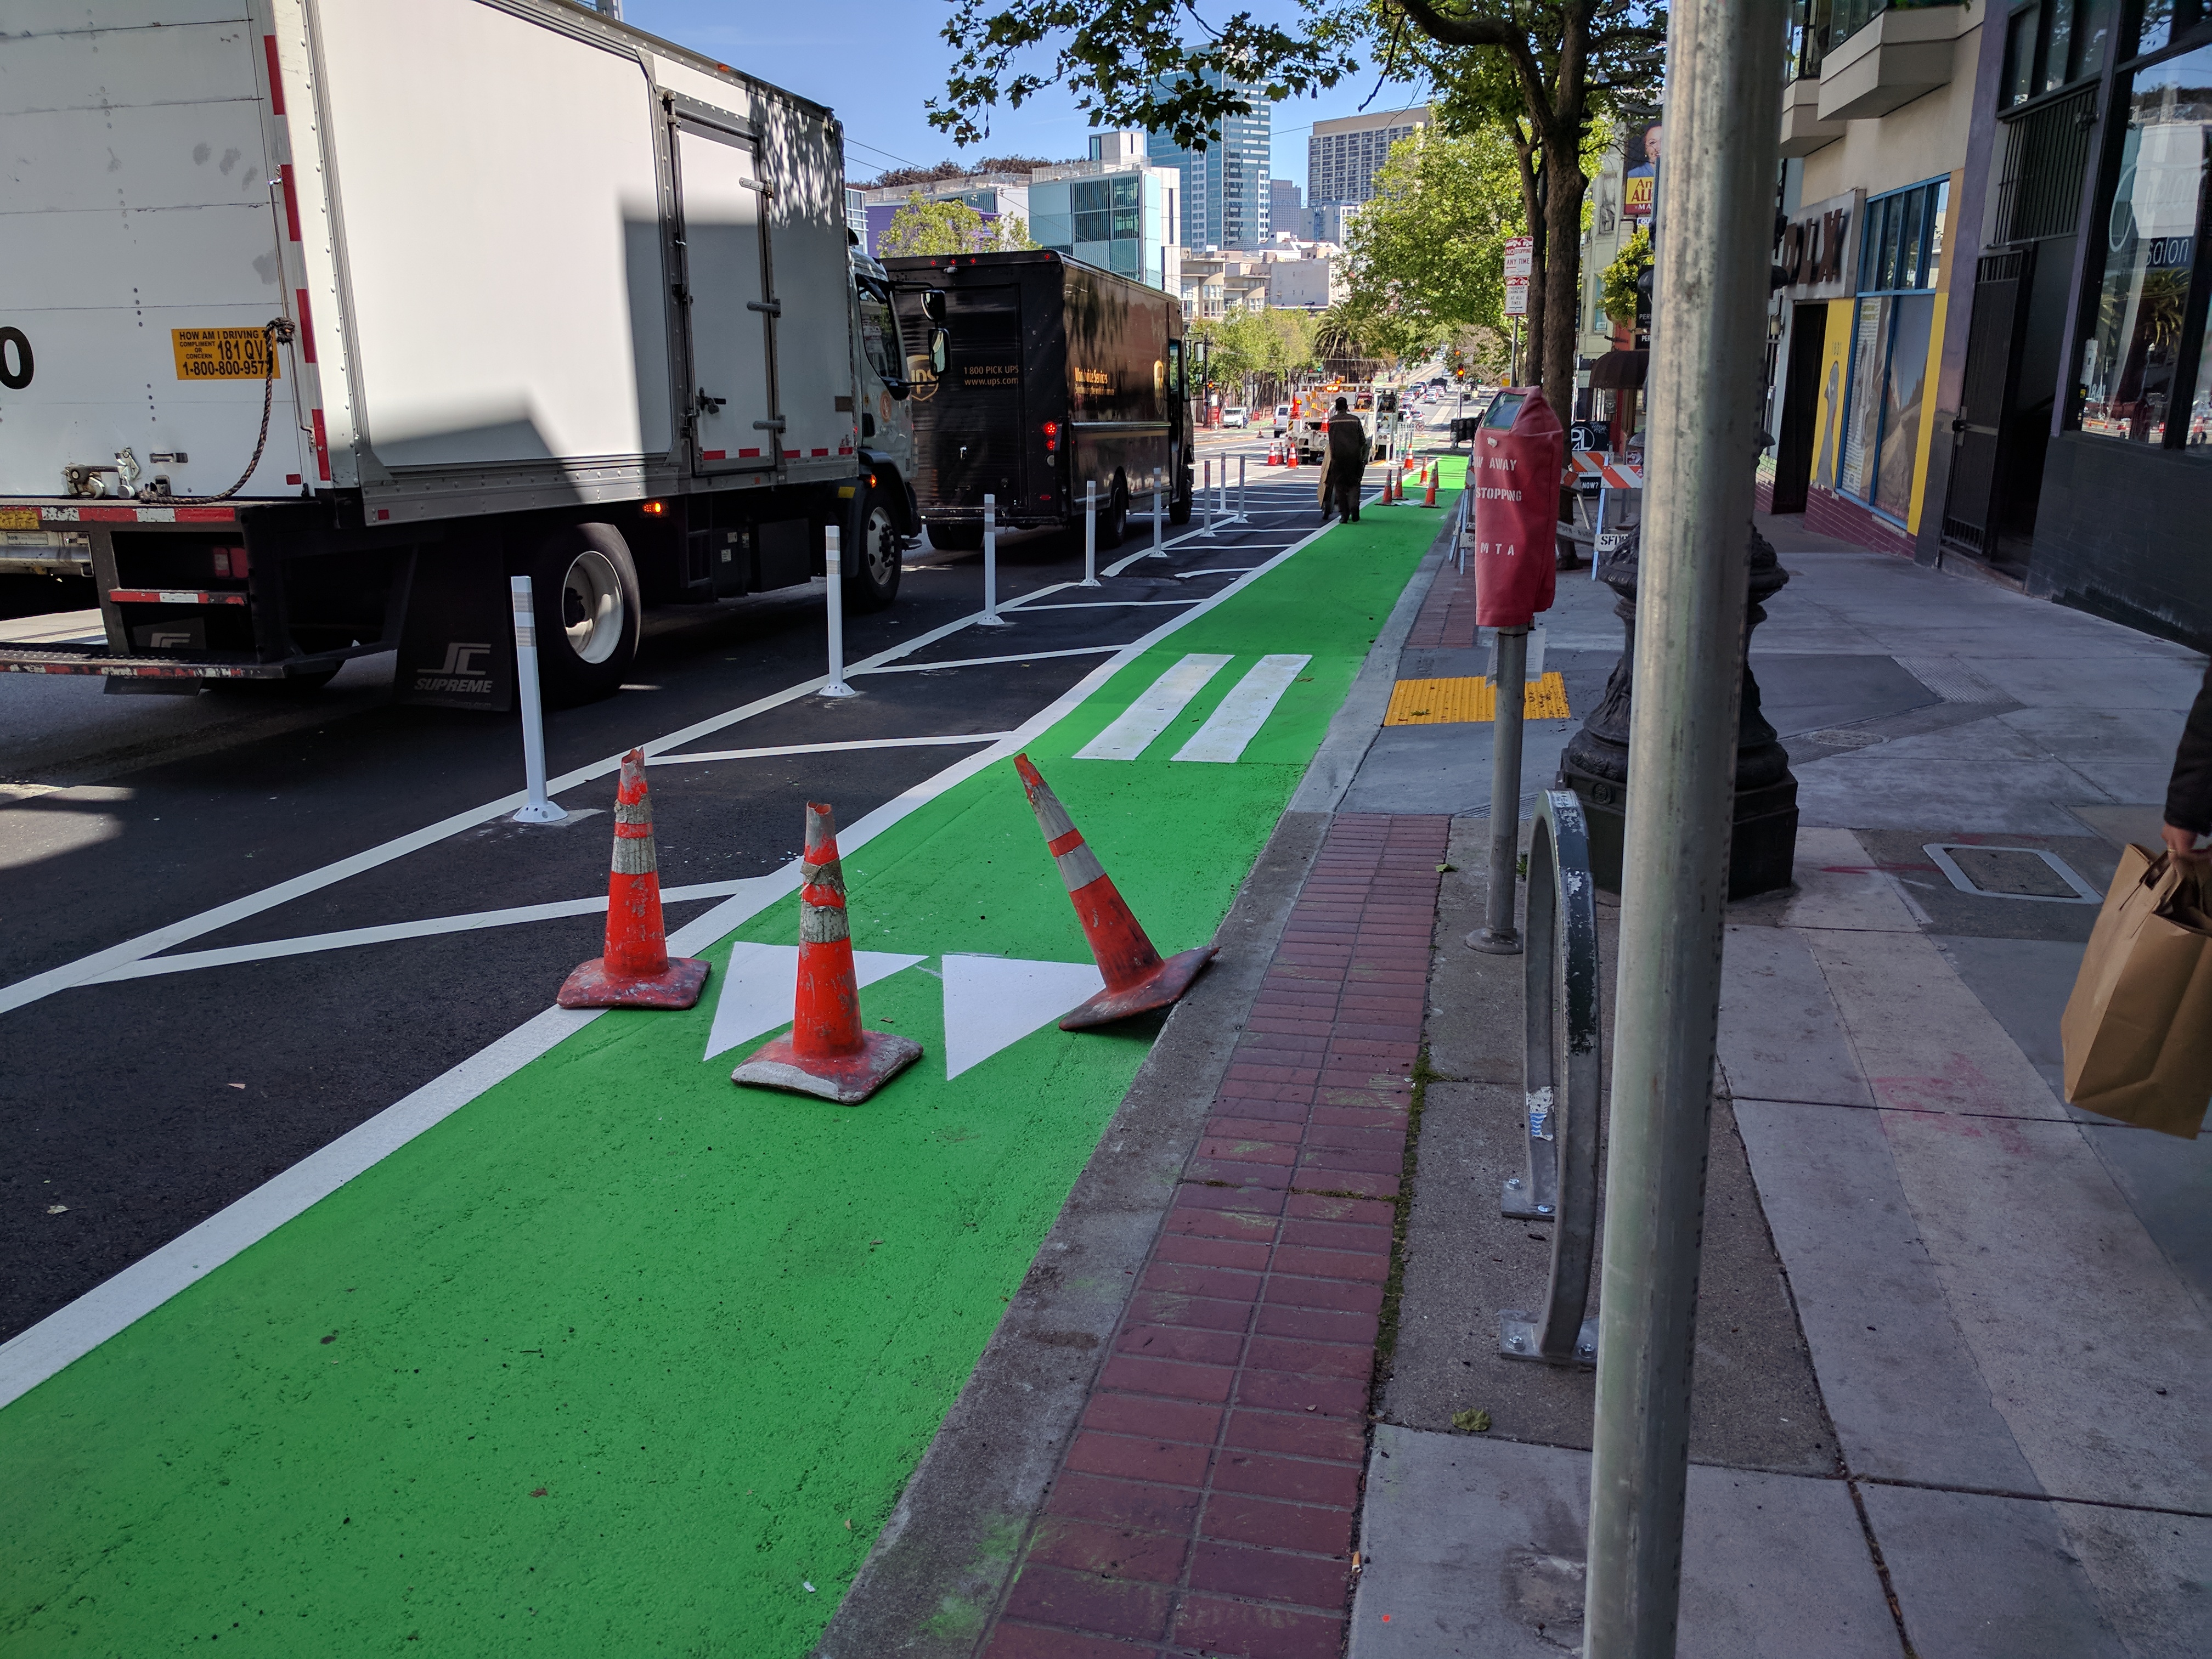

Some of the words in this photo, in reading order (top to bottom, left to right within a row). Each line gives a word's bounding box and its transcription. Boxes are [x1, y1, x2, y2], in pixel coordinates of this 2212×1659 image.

[179, 331, 199, 340] HOW
[202, 331, 215, 340] AM
[217, 331, 221, 339] I
[223, 330, 259, 339] DRIVING
[217, 340, 241, 360] 181
[969, 366, 984, 375] 800
[986, 366, 1003, 374] PICK
[1005, 365, 1019, 374] UPS
[964, 377, 1019, 386] www.ups.com
[1489, 456, 1517, 471] AWAY
[1476, 487, 1522, 501] STOPPING
[414, 678, 493, 693] SUPREME
